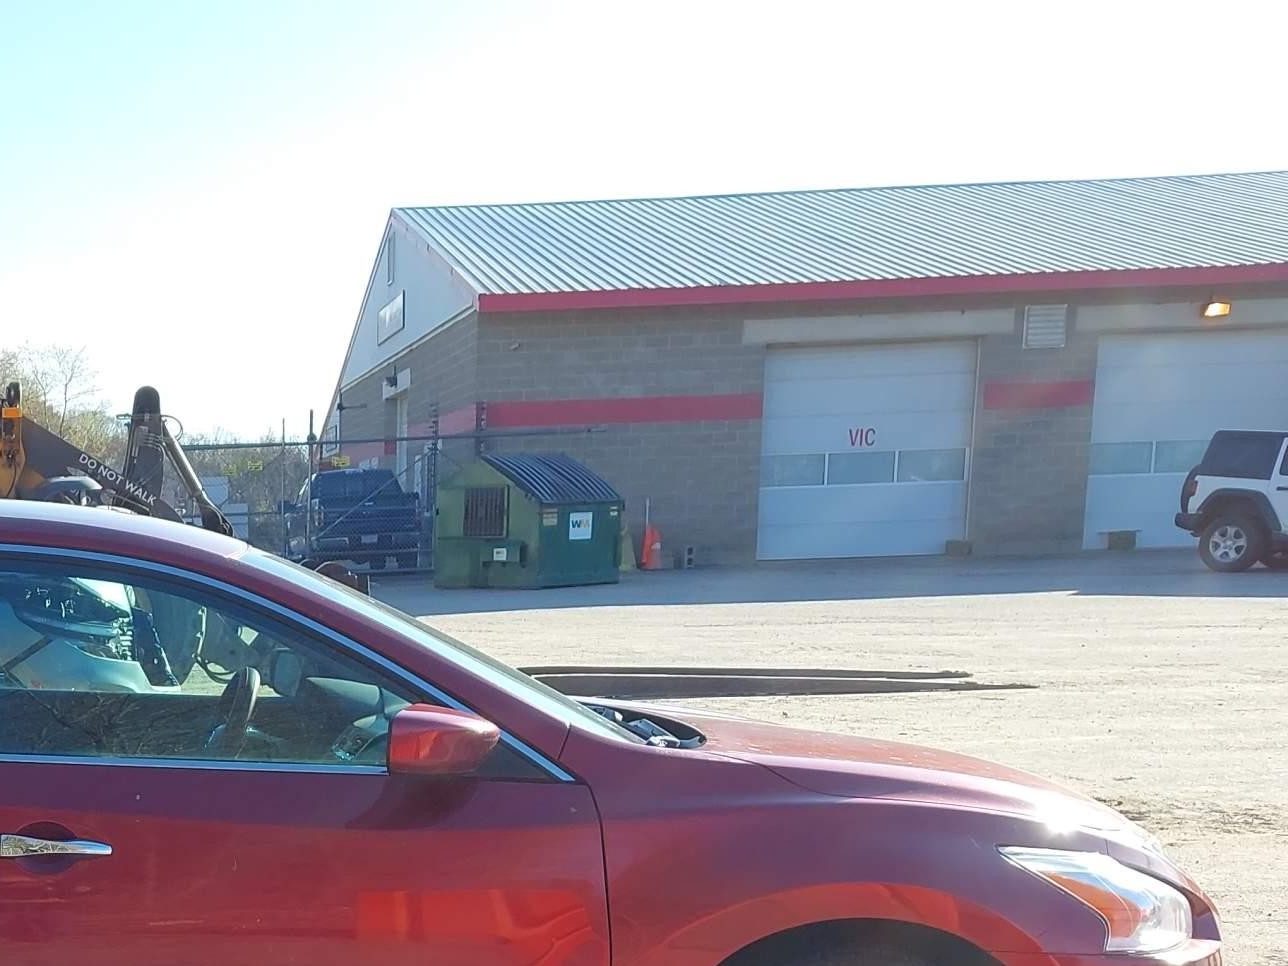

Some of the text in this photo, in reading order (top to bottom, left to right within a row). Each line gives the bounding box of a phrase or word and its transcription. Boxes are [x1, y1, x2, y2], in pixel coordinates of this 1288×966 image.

[848, 427, 877, 447] VIC
[79, 454, 157, 507] DO NOT WALK
